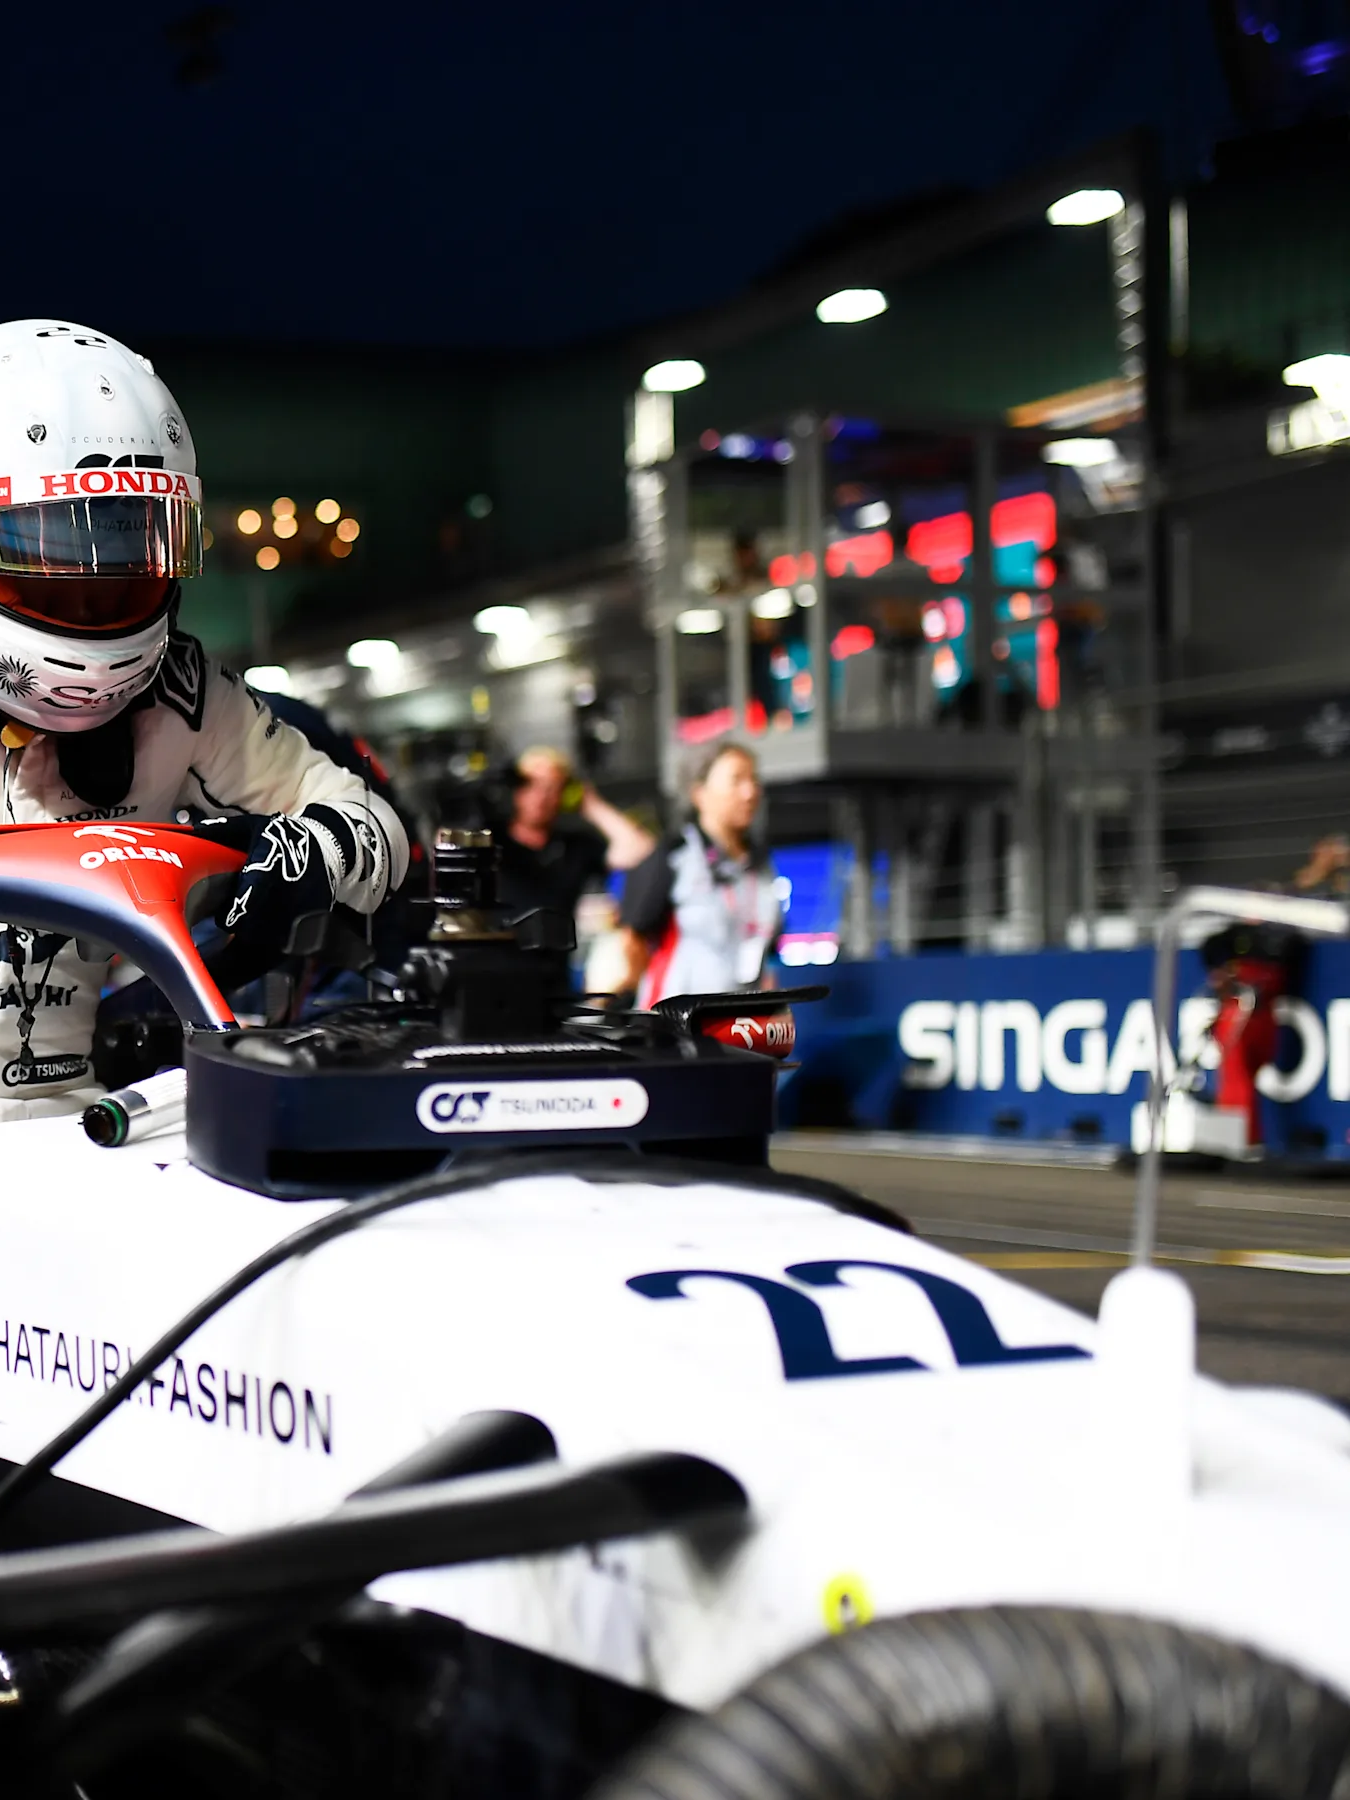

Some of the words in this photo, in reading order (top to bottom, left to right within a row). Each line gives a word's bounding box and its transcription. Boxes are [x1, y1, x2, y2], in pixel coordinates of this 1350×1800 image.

[71, 436, 155, 446] SCUDERIA
[40, 471, 192, 498] HONDA
[79, 846, 184, 870] ORLEN
[625, 1260, 1094, 1382] 22
